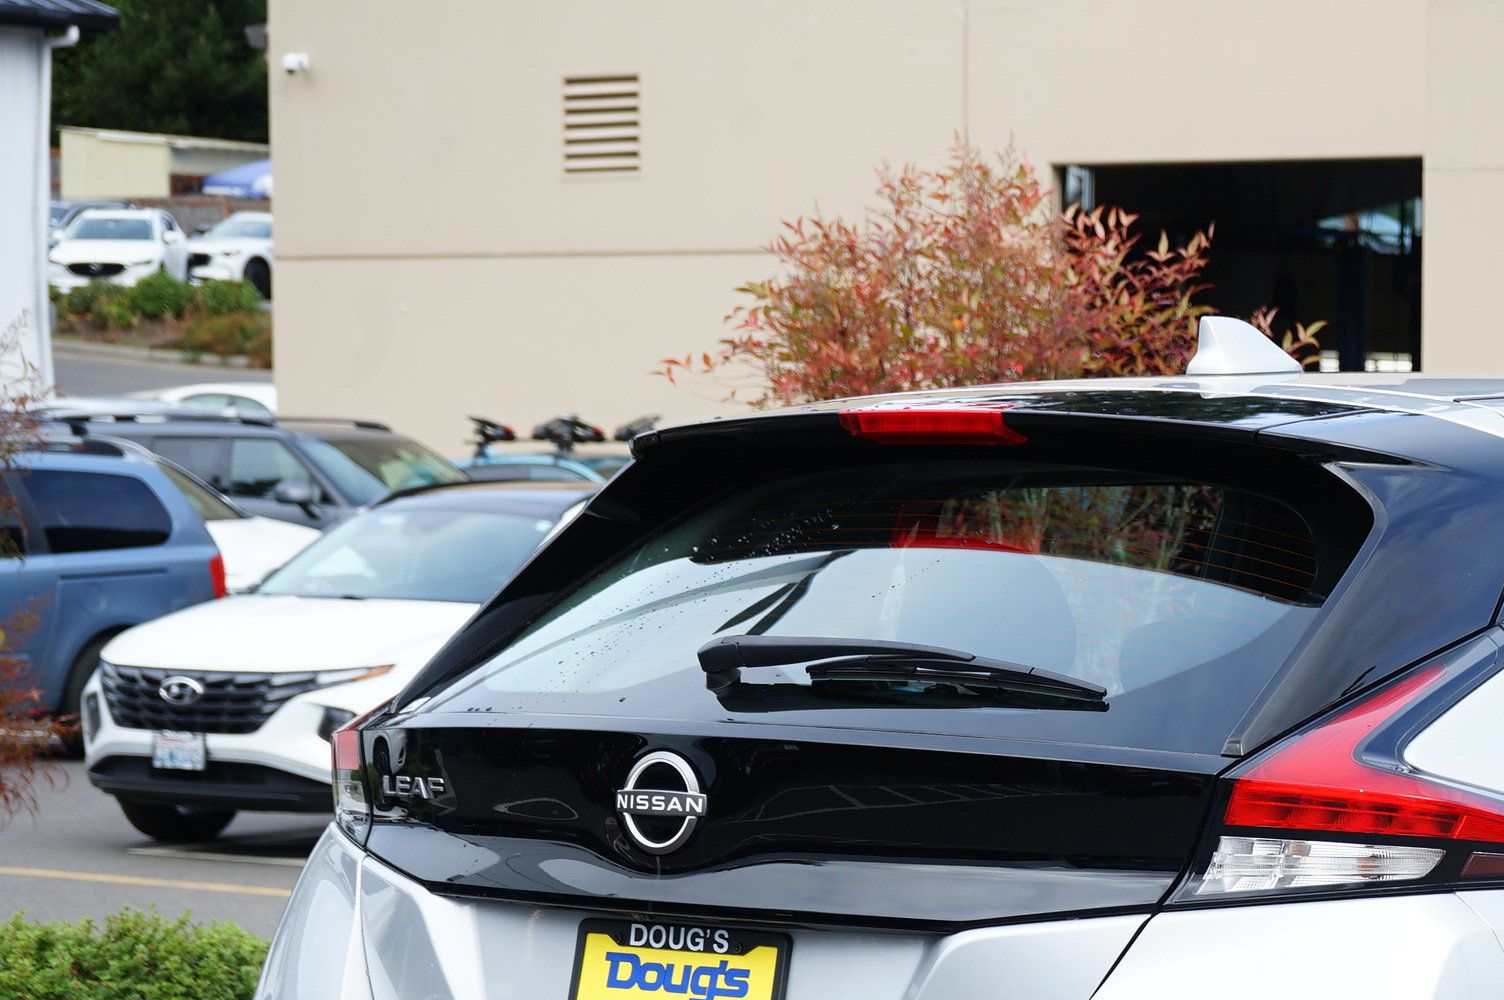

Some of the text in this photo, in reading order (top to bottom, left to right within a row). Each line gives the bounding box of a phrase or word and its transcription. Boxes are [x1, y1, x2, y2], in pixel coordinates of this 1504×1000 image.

[383, 775, 445, 799] LEAF
[617, 793, 703, 813] NISSAN
[629, 923, 730, 953] DOUG'S
